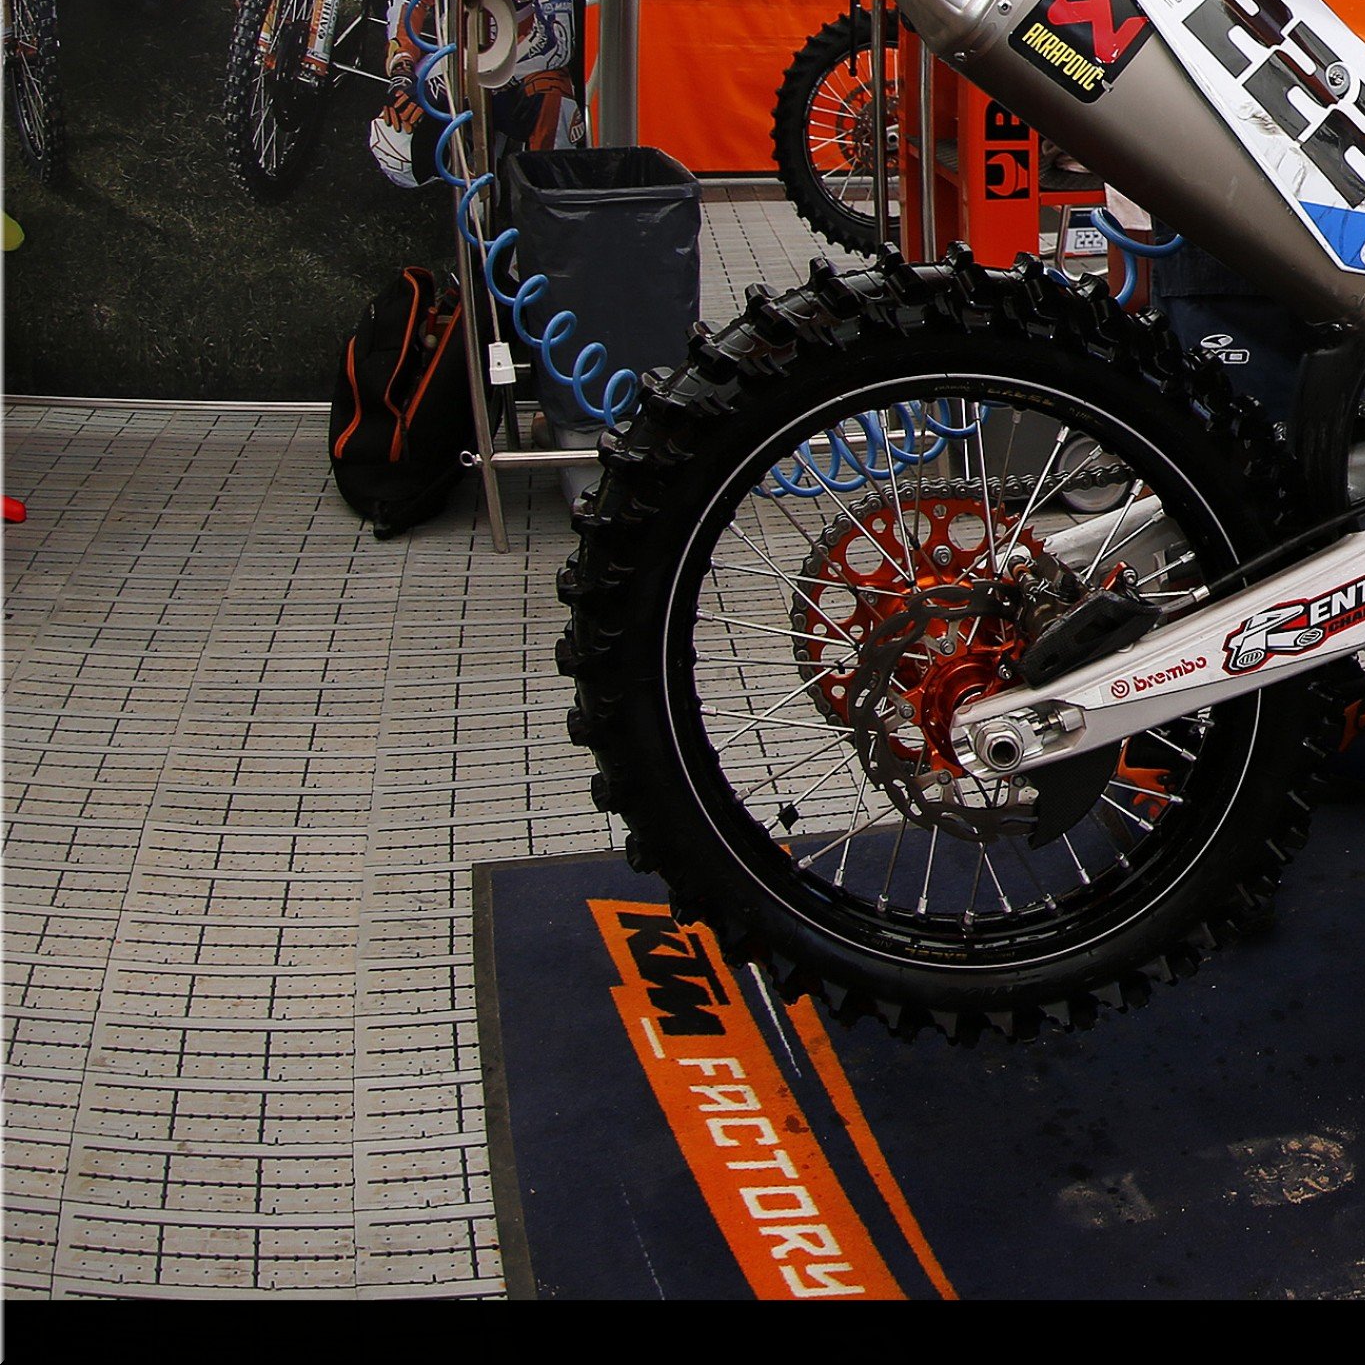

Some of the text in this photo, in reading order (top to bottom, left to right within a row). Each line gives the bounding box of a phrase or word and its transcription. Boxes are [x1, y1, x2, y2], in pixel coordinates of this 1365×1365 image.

[1134, 654, 1208, 693] brembo
[618, 911, 731, 1037] KTM
[679, 1055, 867, 1300] FACTORY
